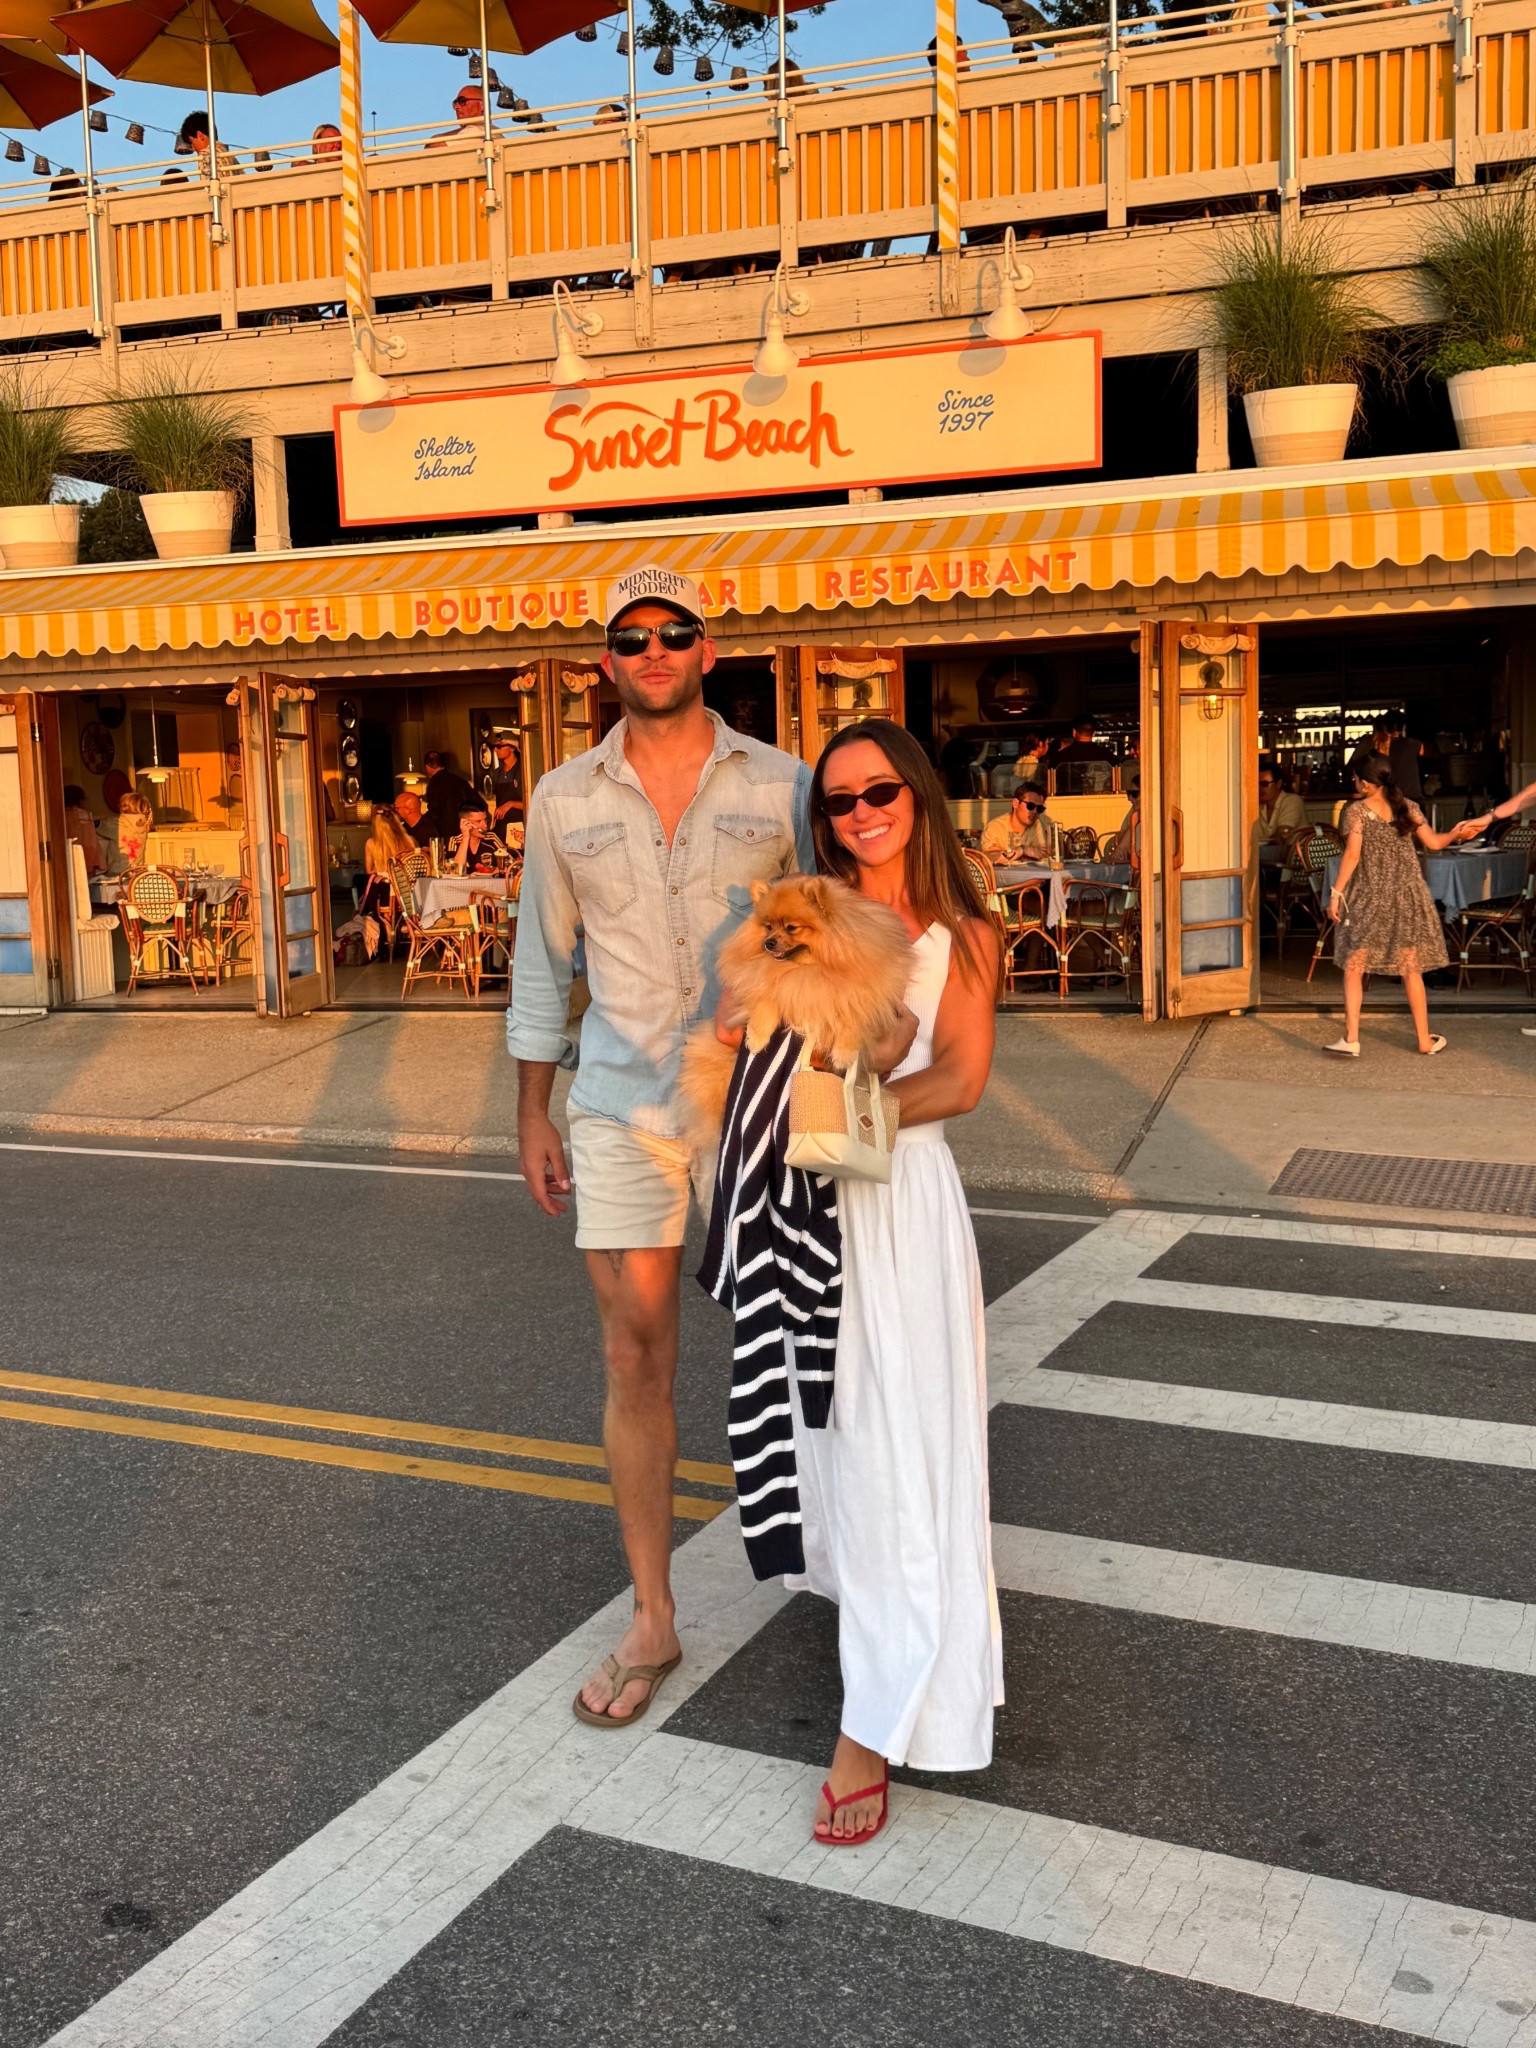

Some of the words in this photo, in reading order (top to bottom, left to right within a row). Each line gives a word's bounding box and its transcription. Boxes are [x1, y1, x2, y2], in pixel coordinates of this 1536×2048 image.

[938, 389, 994, 413] Since
[939, 411, 994, 434] 1997
[414, 435, 476, 460] Shelter
[544, 399, 704, 491] Sunset
[694, 381, 854, 469] Beach
[414, 457, 474, 480] Island
[618, 569, 687, 594] MIDNIGHT
[628, 581, 678, 599] RODEO
[235, 607, 340, 637] HOTEL
[415, 589, 589, 626] BOUTIQUE
[697, 579, 738, 607] AR
[825, 552, 1077, 599] RESTAURANT
